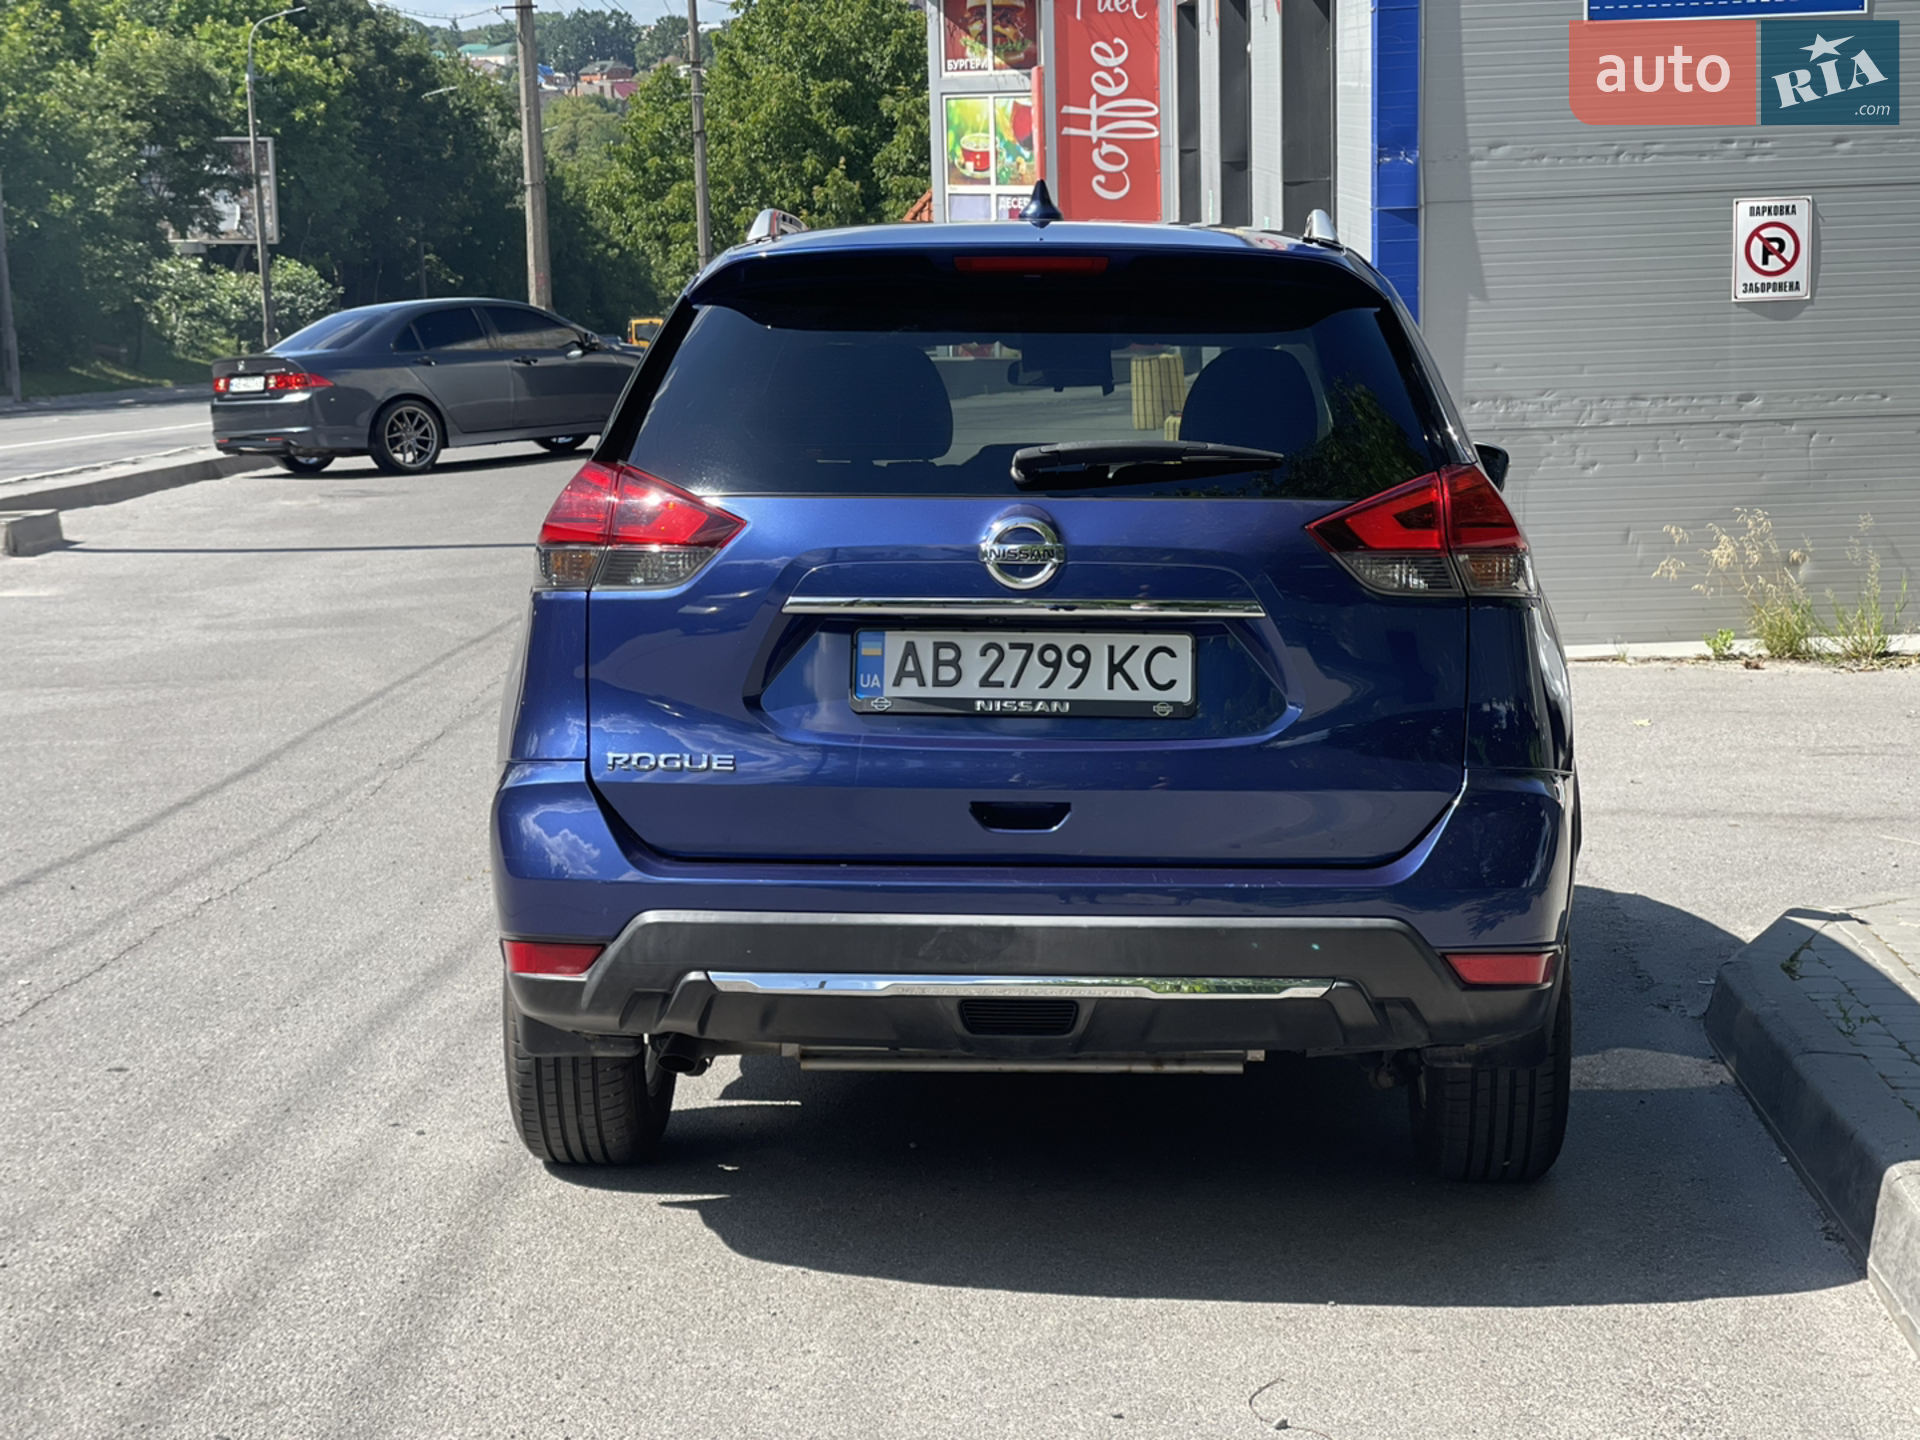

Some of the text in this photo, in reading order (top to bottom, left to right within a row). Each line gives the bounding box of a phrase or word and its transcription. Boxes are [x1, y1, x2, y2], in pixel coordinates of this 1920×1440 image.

[1061, 37, 1159, 200] coffee
[1749, 204, 1797, 217] ПАРКОВКА
[1742, 280, 1801, 294] ЗАБОРОНЕНА
[989, 547, 1055, 559] NISSAN
[892, 641, 1178, 691] AB 2799 KC
[859, 673, 881, 688] UA
[974, 700, 1070, 713] NISSAN
[606, 751, 736, 772] ROGUE
